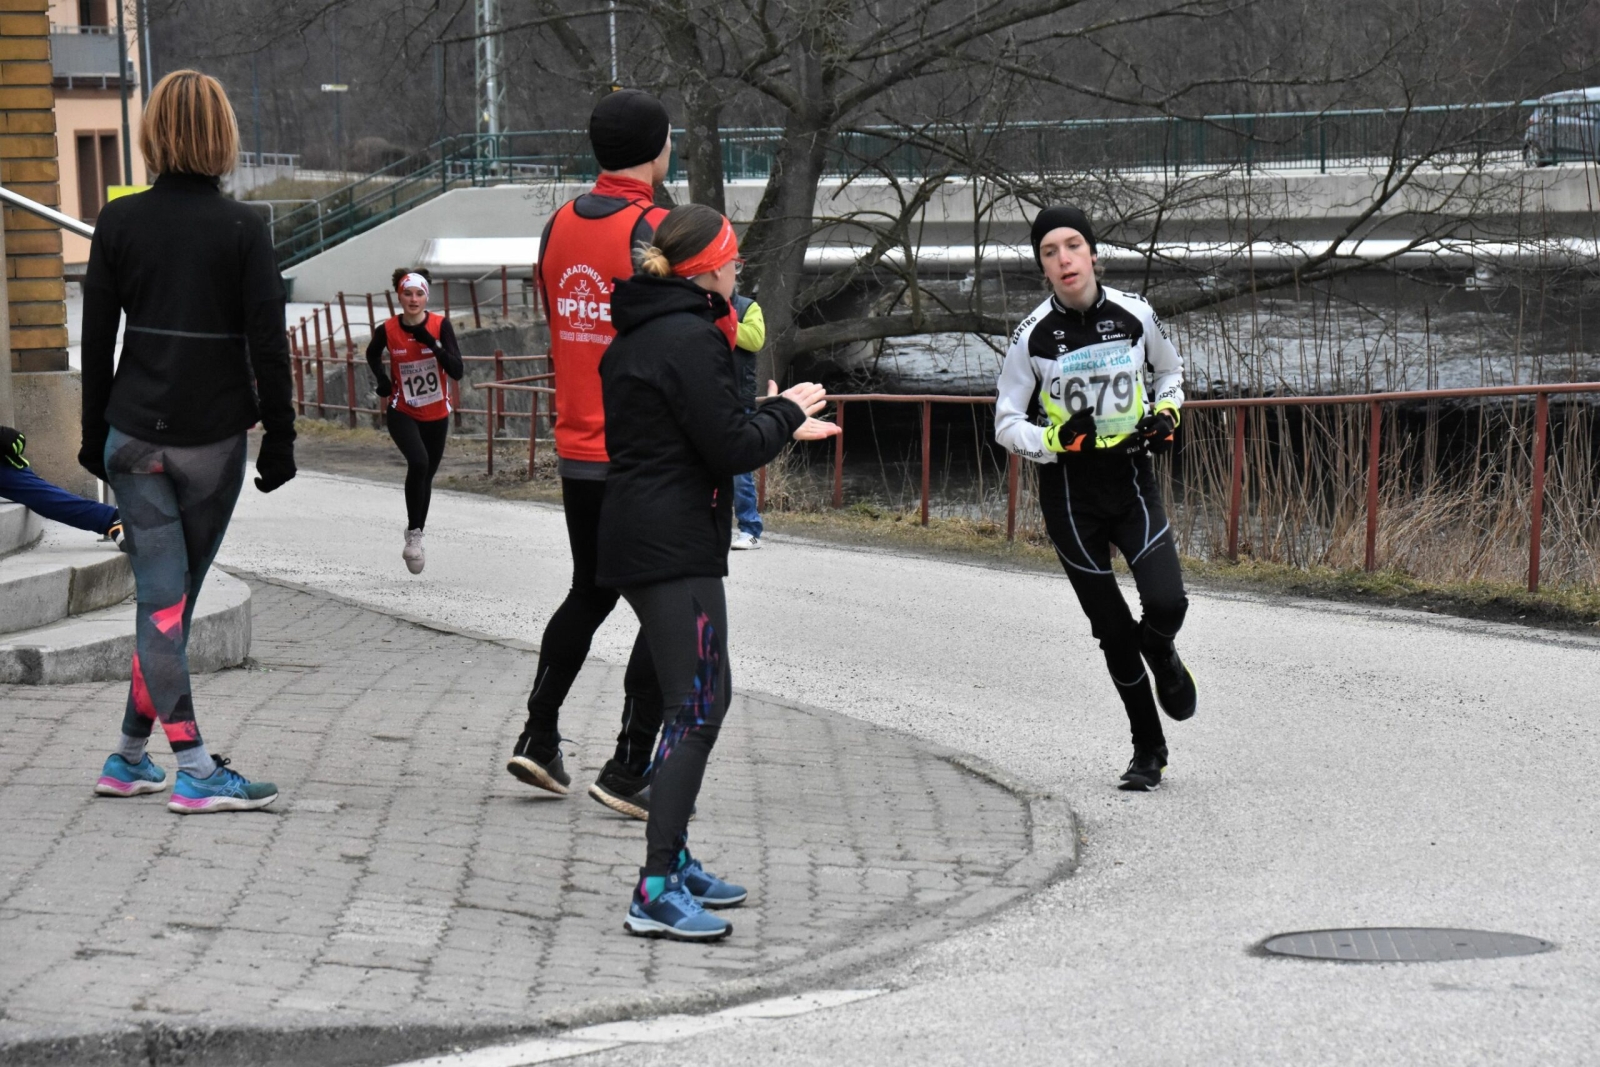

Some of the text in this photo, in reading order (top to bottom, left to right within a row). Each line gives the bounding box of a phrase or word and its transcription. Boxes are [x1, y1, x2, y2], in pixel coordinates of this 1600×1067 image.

[559, 264, 610, 295] MARATONSTAV
[1012, 316, 1037, 346] ELEKTRO
[1110, 355, 1132, 366] LIGA
[404, 371, 438, 398] 129
[1064, 371, 1134, 416] 679
